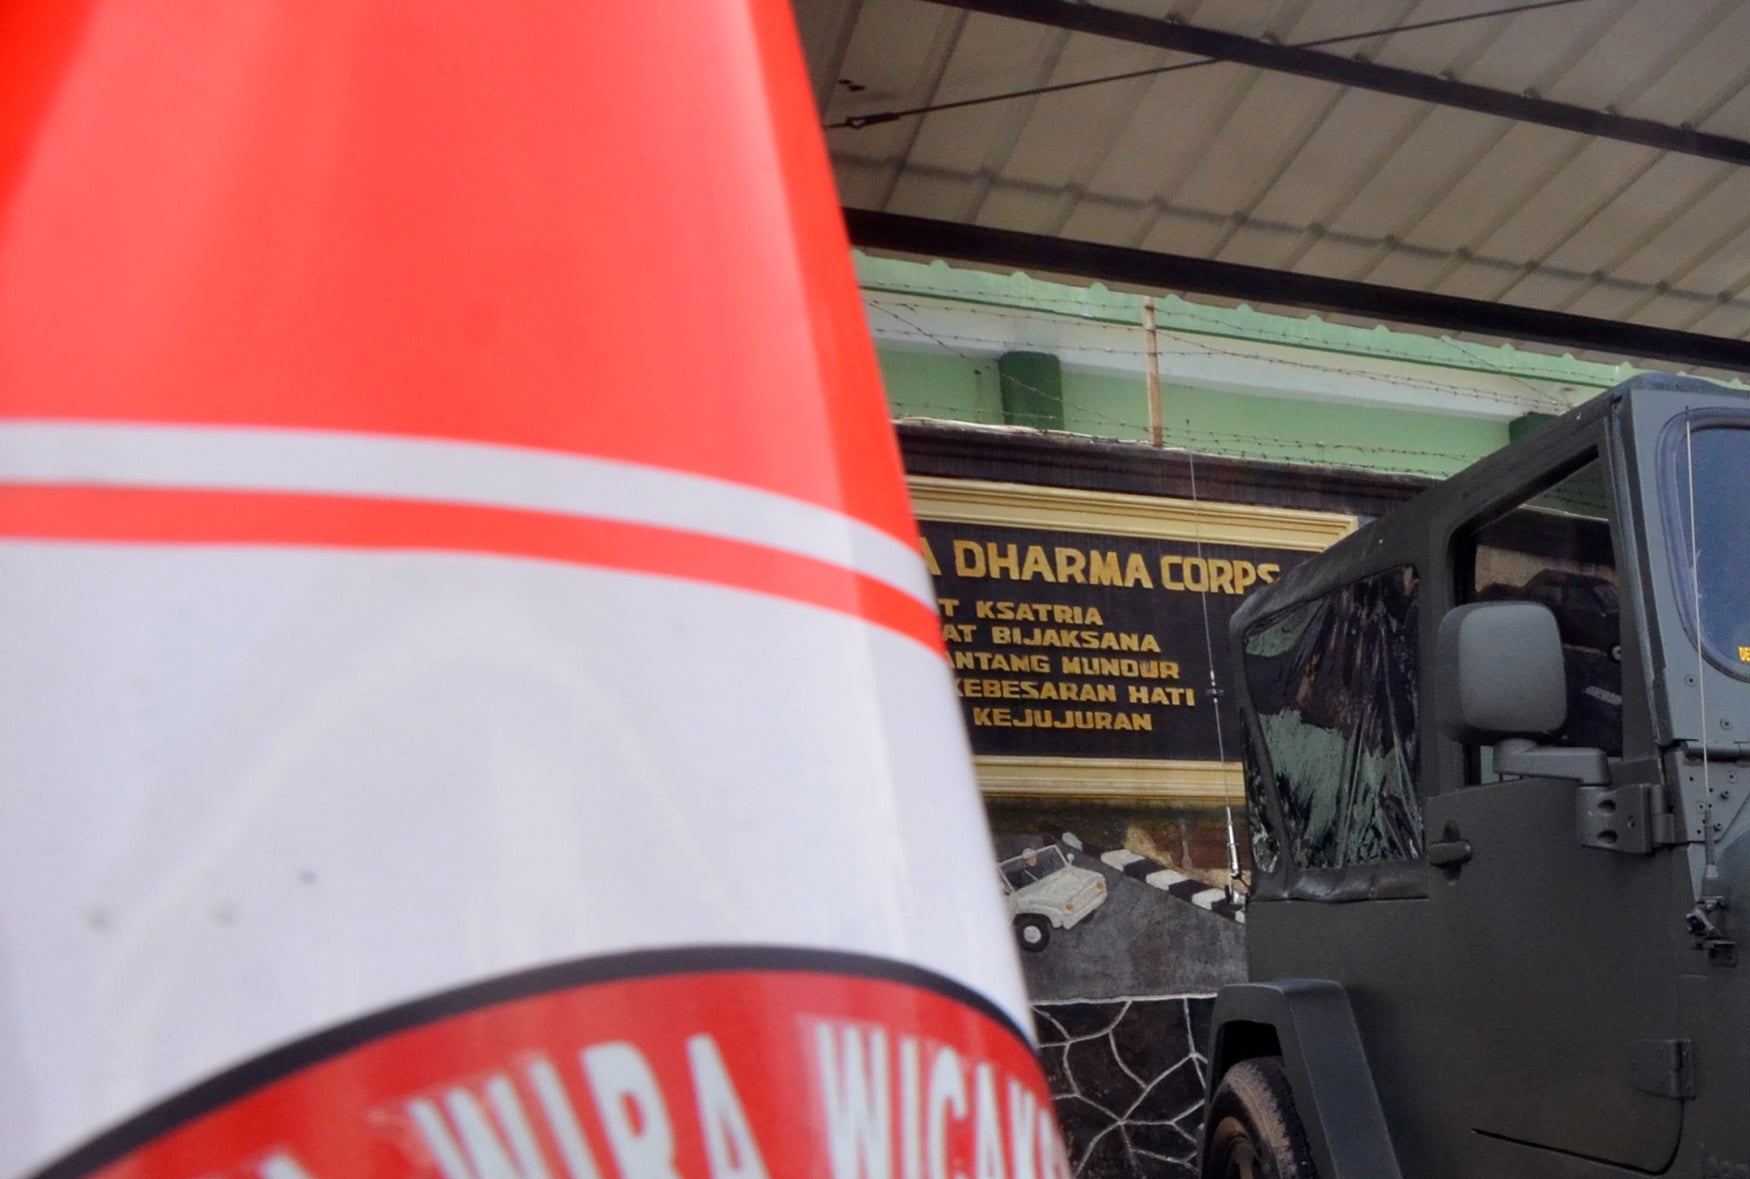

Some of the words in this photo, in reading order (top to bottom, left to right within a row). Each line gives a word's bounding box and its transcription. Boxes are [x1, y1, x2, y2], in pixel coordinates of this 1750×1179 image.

[953, 540, 1153, 591] DHARMA
[1161, 554, 1280, 595] CORPS
[976, 600, 1104, 626] KSATRIA
[991, 626, 1161, 653] BIJAKSANA
[1061, 656, 1180, 679] MUNDUR
[1128, 684, 1195, 706] HATI
[972, 706, 1152, 731] KEJUJURAN
